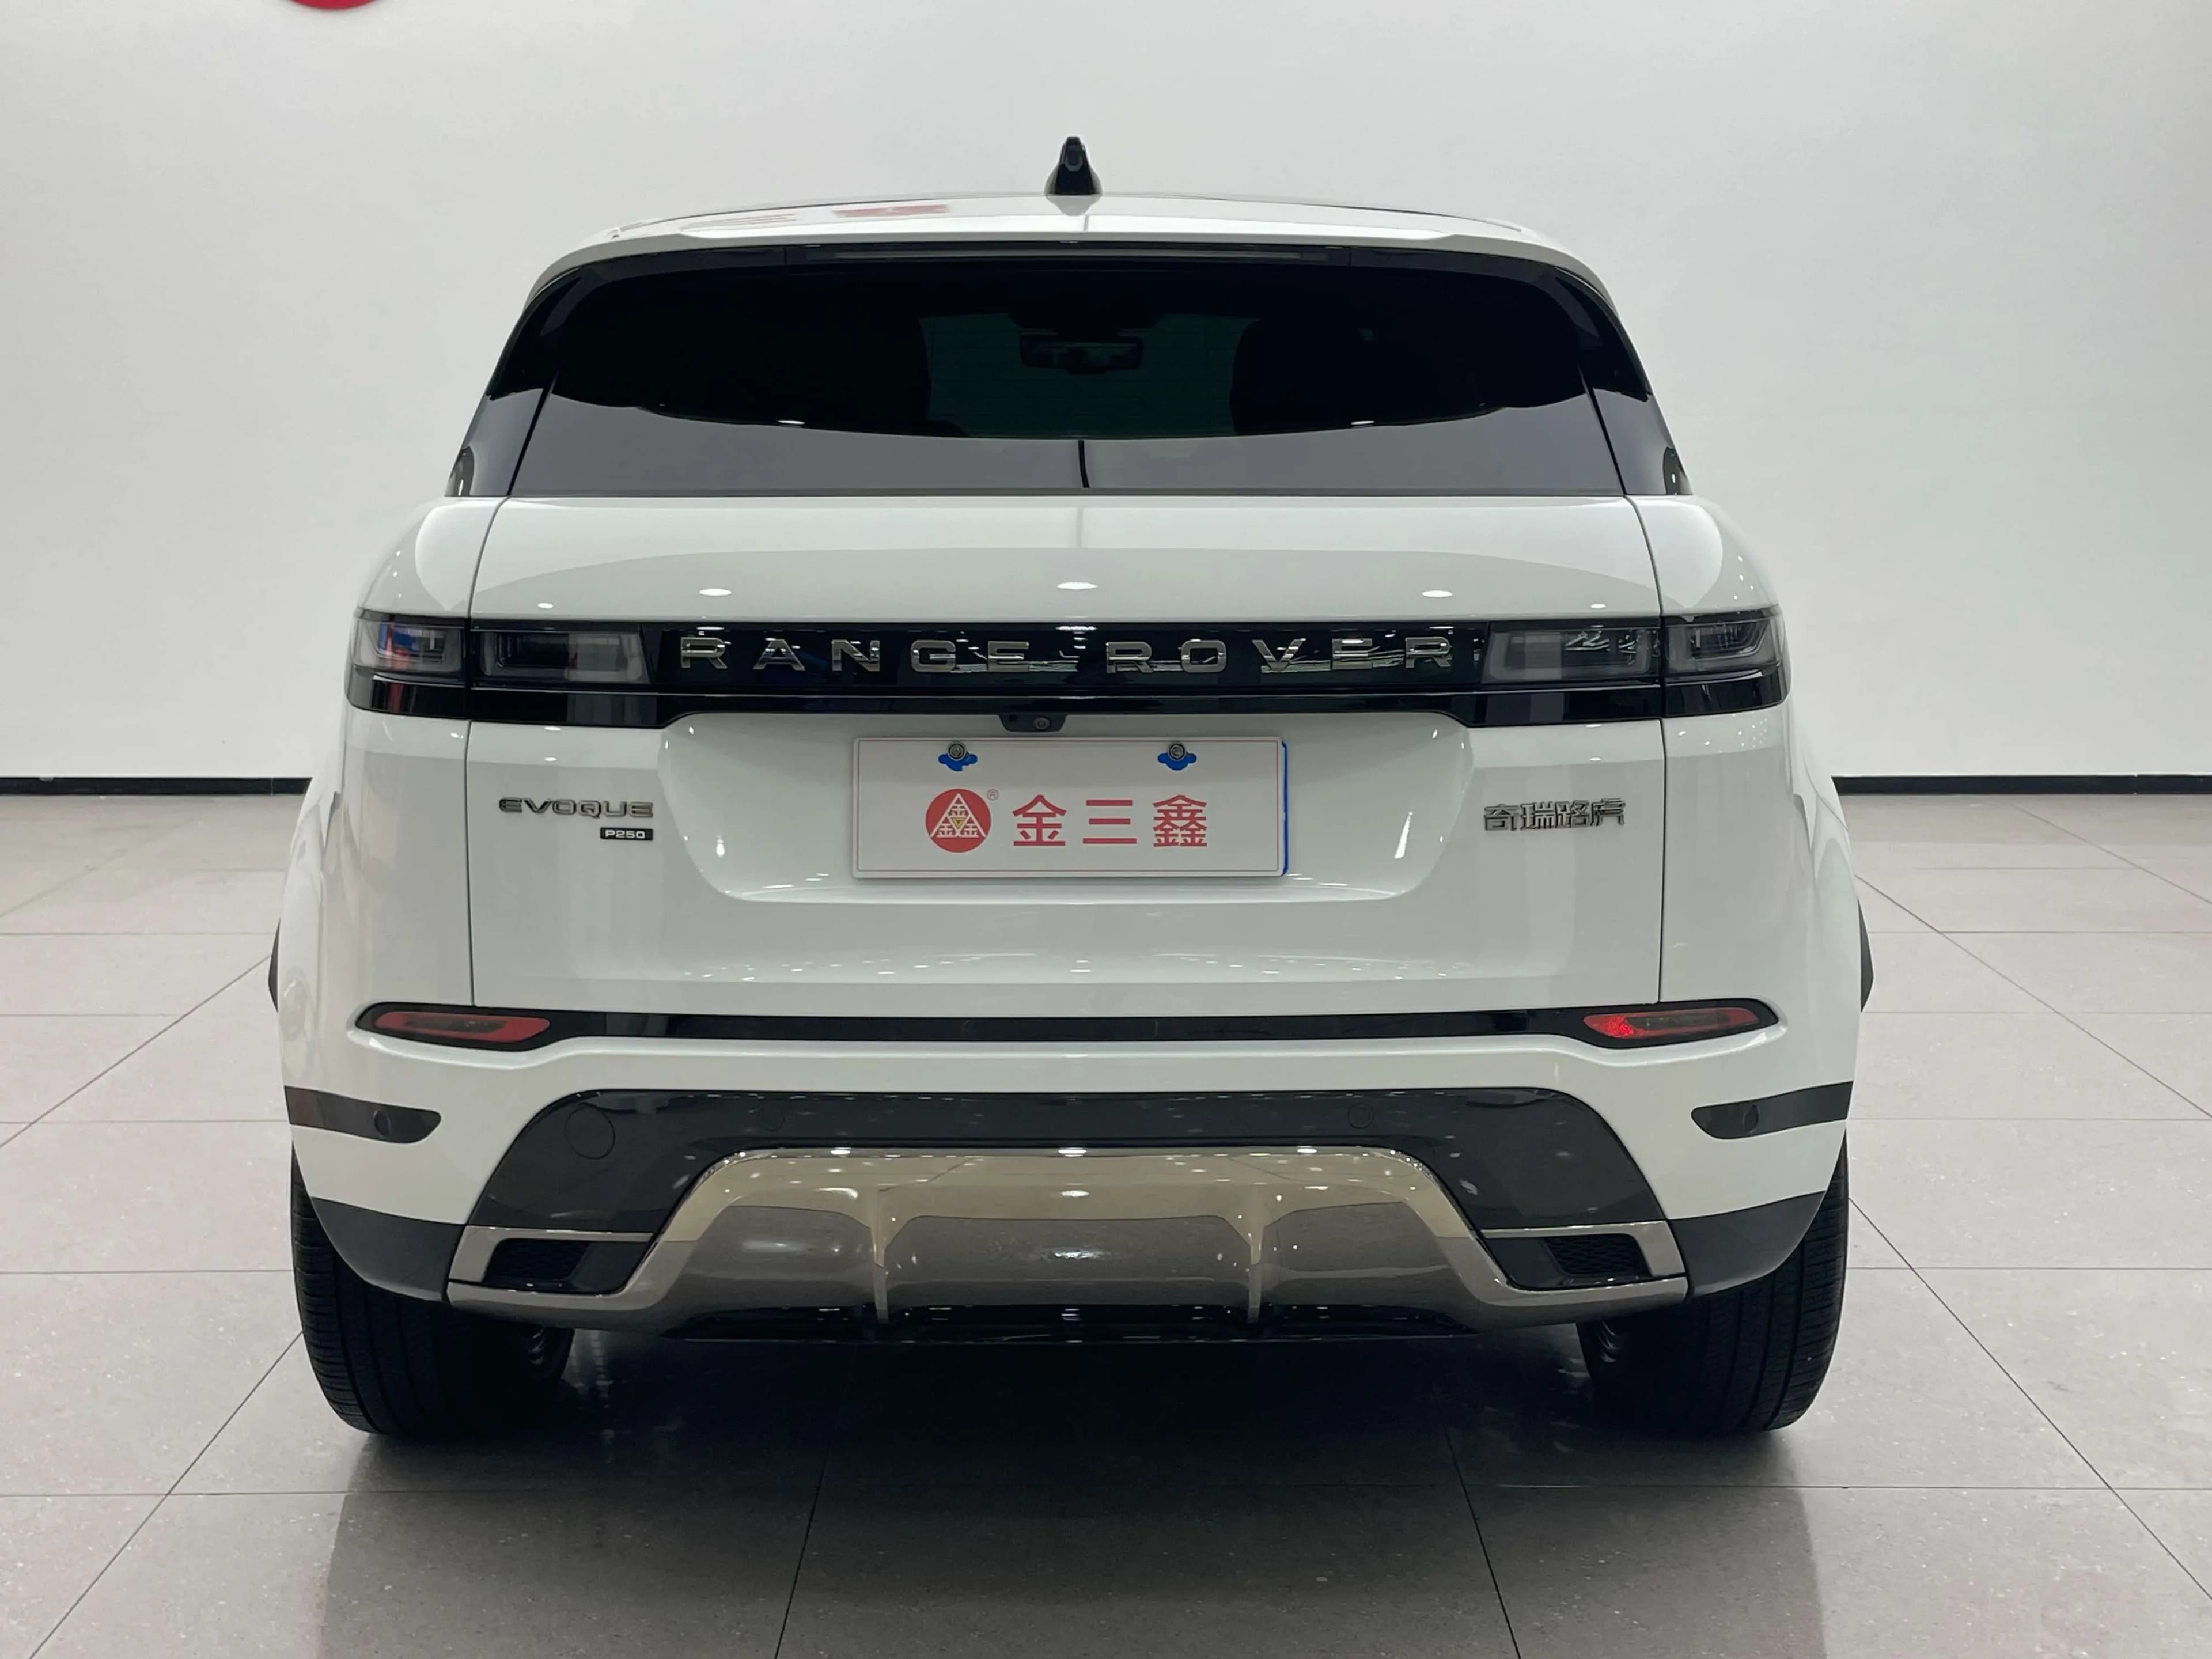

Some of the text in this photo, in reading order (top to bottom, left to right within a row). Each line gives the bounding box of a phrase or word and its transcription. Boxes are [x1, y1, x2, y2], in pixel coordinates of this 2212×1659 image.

[680, 637, 1452, 673] RANGE ROVER
[499, 797, 653, 819] EVOQUE
[1012, 794, 1208, 847] 金三鑫
[1483, 798, 1626, 831] 奇瑞路虎
[605, 830, 645, 839] P250
